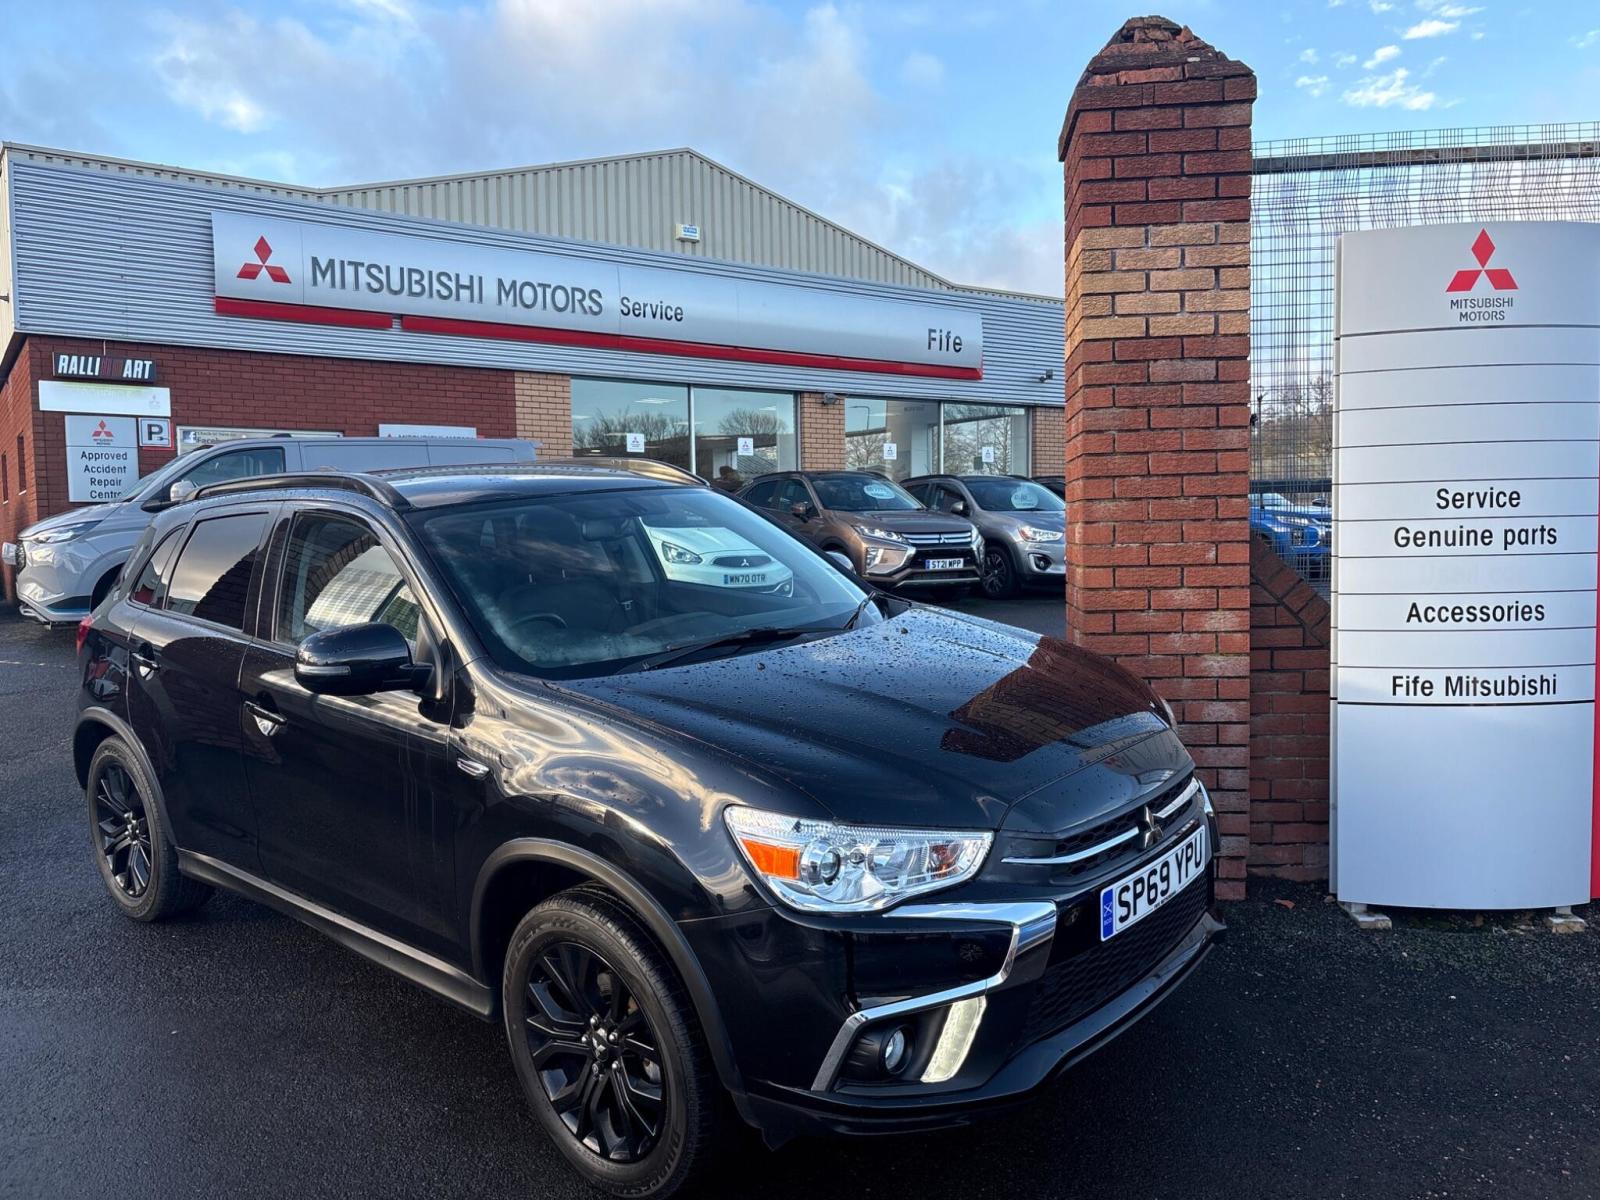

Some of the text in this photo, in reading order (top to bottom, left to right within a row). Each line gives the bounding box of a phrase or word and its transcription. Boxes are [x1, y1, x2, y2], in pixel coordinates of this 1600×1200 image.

[310, 256, 684, 323] MITSUBISHI MOTORS Service
[1450, 297, 1514, 310] MITSUBISHI
[1459, 309, 1506, 322] MOTORS
[927, 328, 963, 353] Fife
[147, 423, 164, 441] P
[80, 450, 128, 462] Approved
[83, 464, 127, 474] Accident
[90, 477, 122, 488] Repair
[1435, 486, 1522, 510] Service
[1393, 524, 1558, 551] Genuine parts
[1405, 600, 1546, 624] Accessories
[1391, 673, 1557, 697] Fife Mitsubishi
[1118, 832, 1203, 923] SP69 YPU
